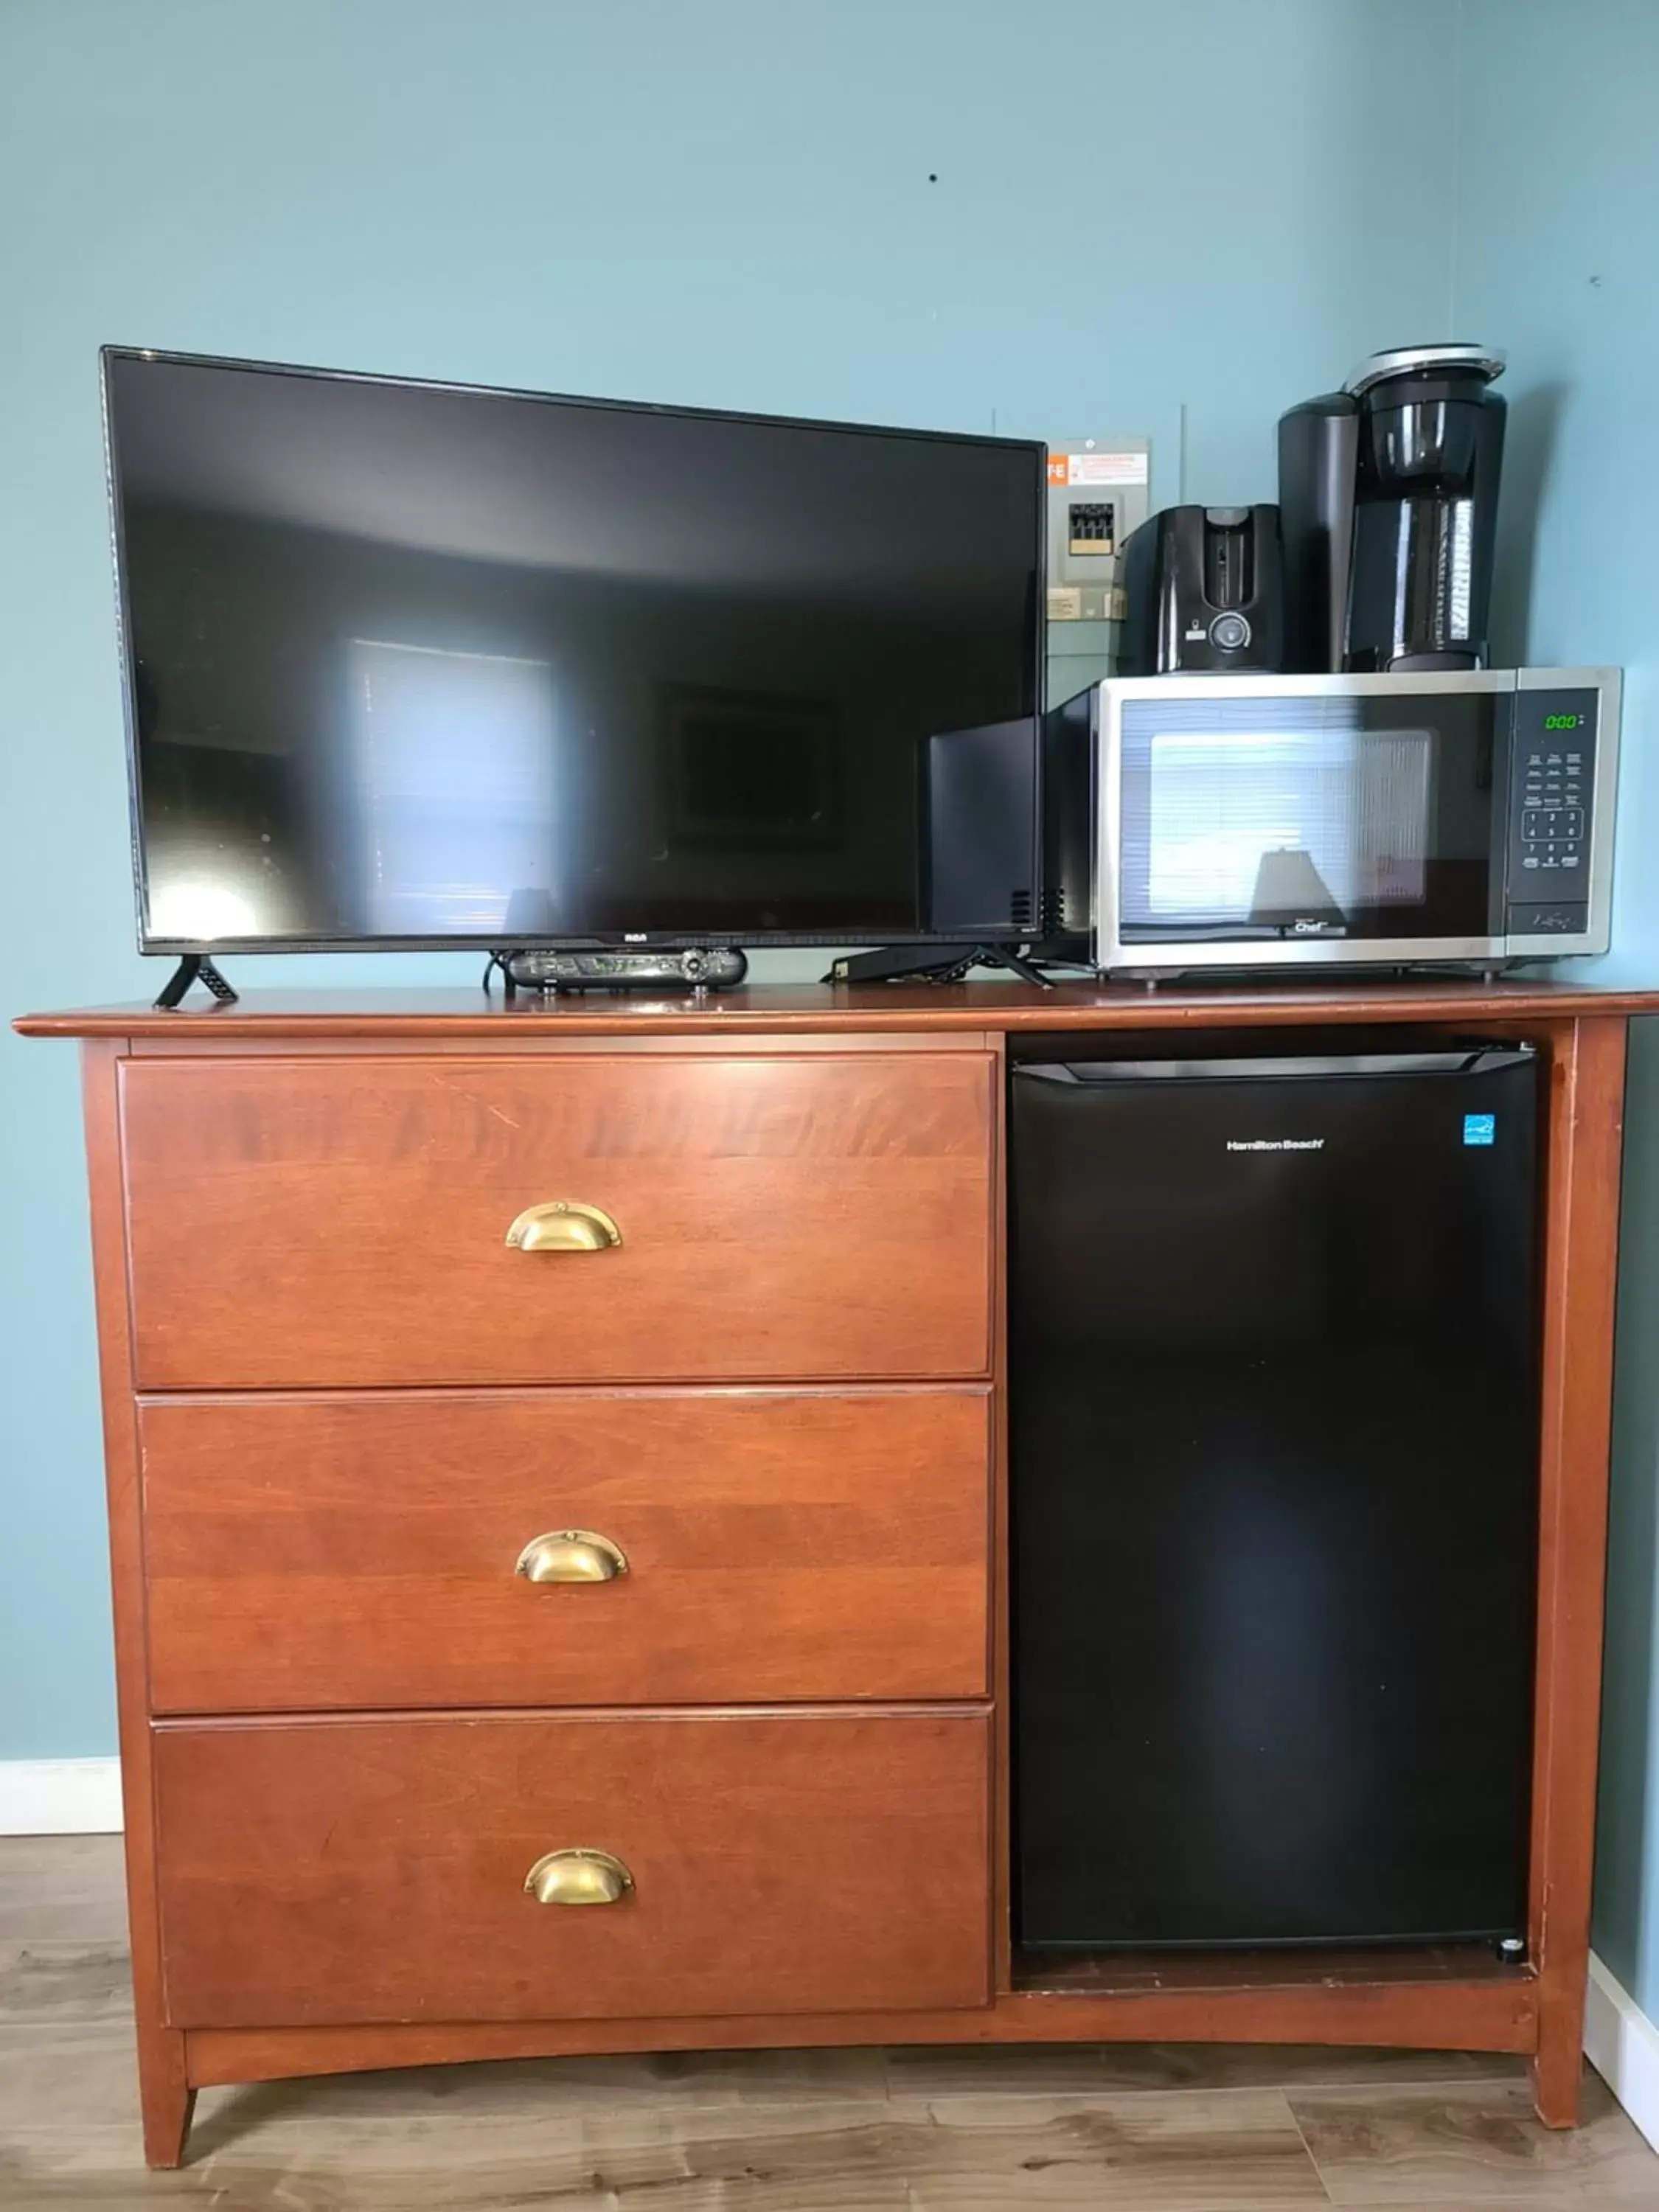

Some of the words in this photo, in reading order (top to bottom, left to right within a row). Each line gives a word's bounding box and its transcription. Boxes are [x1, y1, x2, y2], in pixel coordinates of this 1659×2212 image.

[625, 933, 647, 942] RCA
[1227, 1140, 1282, 1151] Hamilton
[1283, 1139, 1323, 1150] Beach
